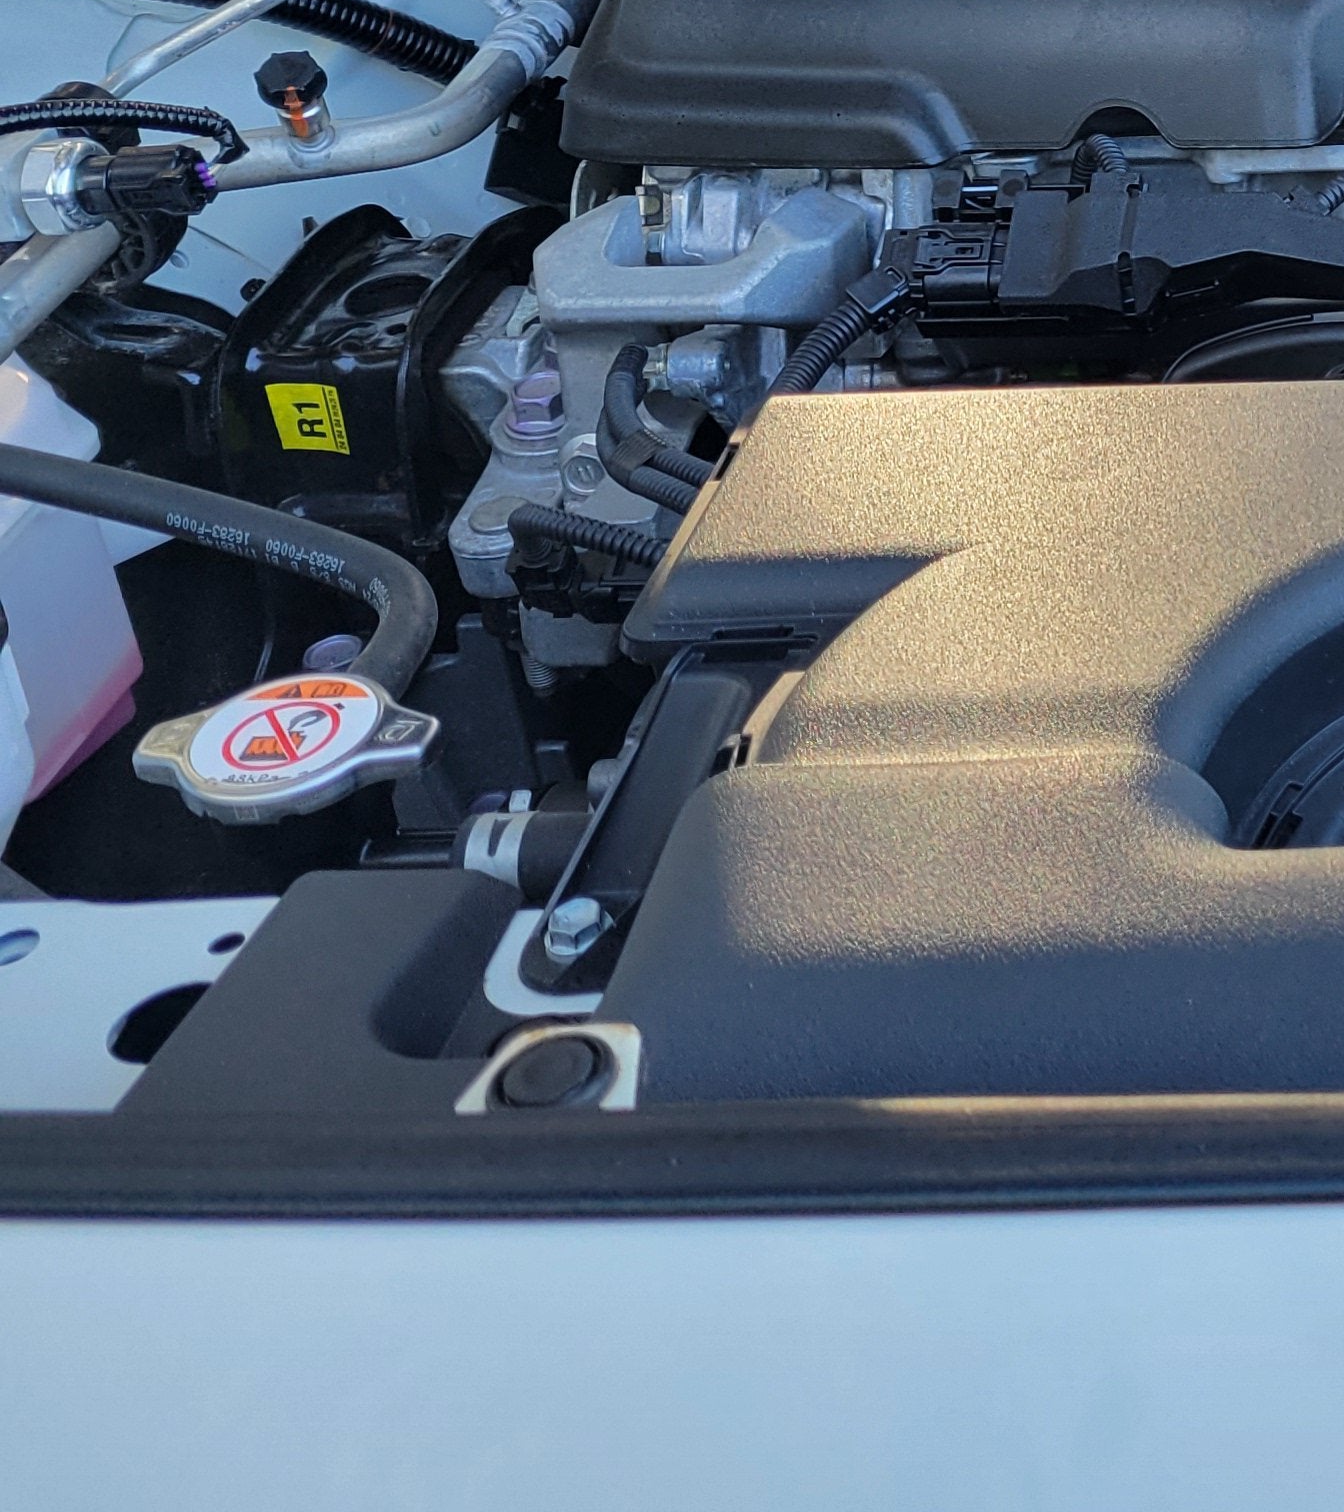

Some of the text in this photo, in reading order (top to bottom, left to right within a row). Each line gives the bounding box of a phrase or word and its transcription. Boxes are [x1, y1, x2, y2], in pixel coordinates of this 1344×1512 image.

[292, 402, 327, 438] R1
[165, 512, 251, 546] 16283-F0060
[265, 538, 345, 575] 16283-F0060
